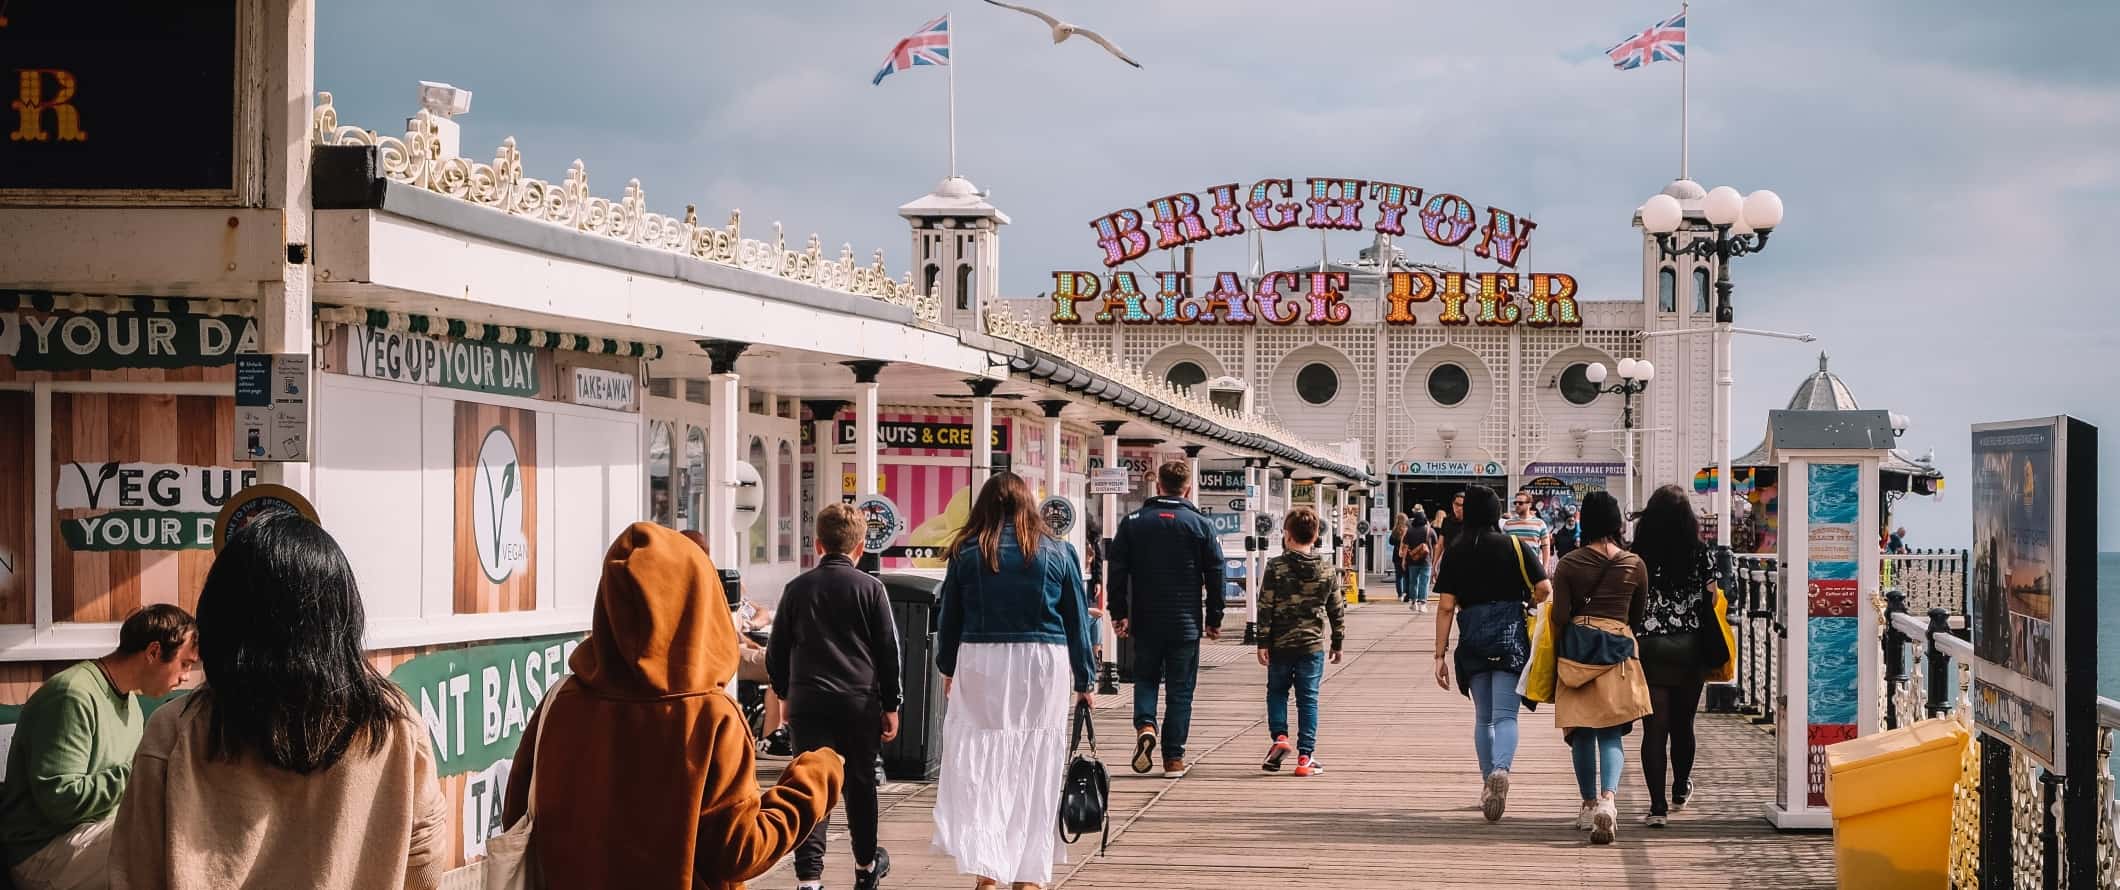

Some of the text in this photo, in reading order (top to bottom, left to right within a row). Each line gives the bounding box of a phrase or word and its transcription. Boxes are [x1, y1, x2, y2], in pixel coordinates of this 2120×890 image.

[1089, 177, 1538, 268] BRIGHTON
[1051, 270, 1582, 328] PALACE PIER
[25, 316, 177, 355] YOUR
[405, 336, 436, 384] UP
[442, 342, 495, 387] YOUR
[501, 348, 535, 390] DAY
[845, 424, 999, 446] DNUTS & CRES
[1426, 462, 1468, 470] THIS WAY
[1534, 466, 1626, 474] WHERE TICKETS MAKE PRIZE
[78, 517, 182, 545] YOUR
[502, 543, 529, 561] VEGAN
